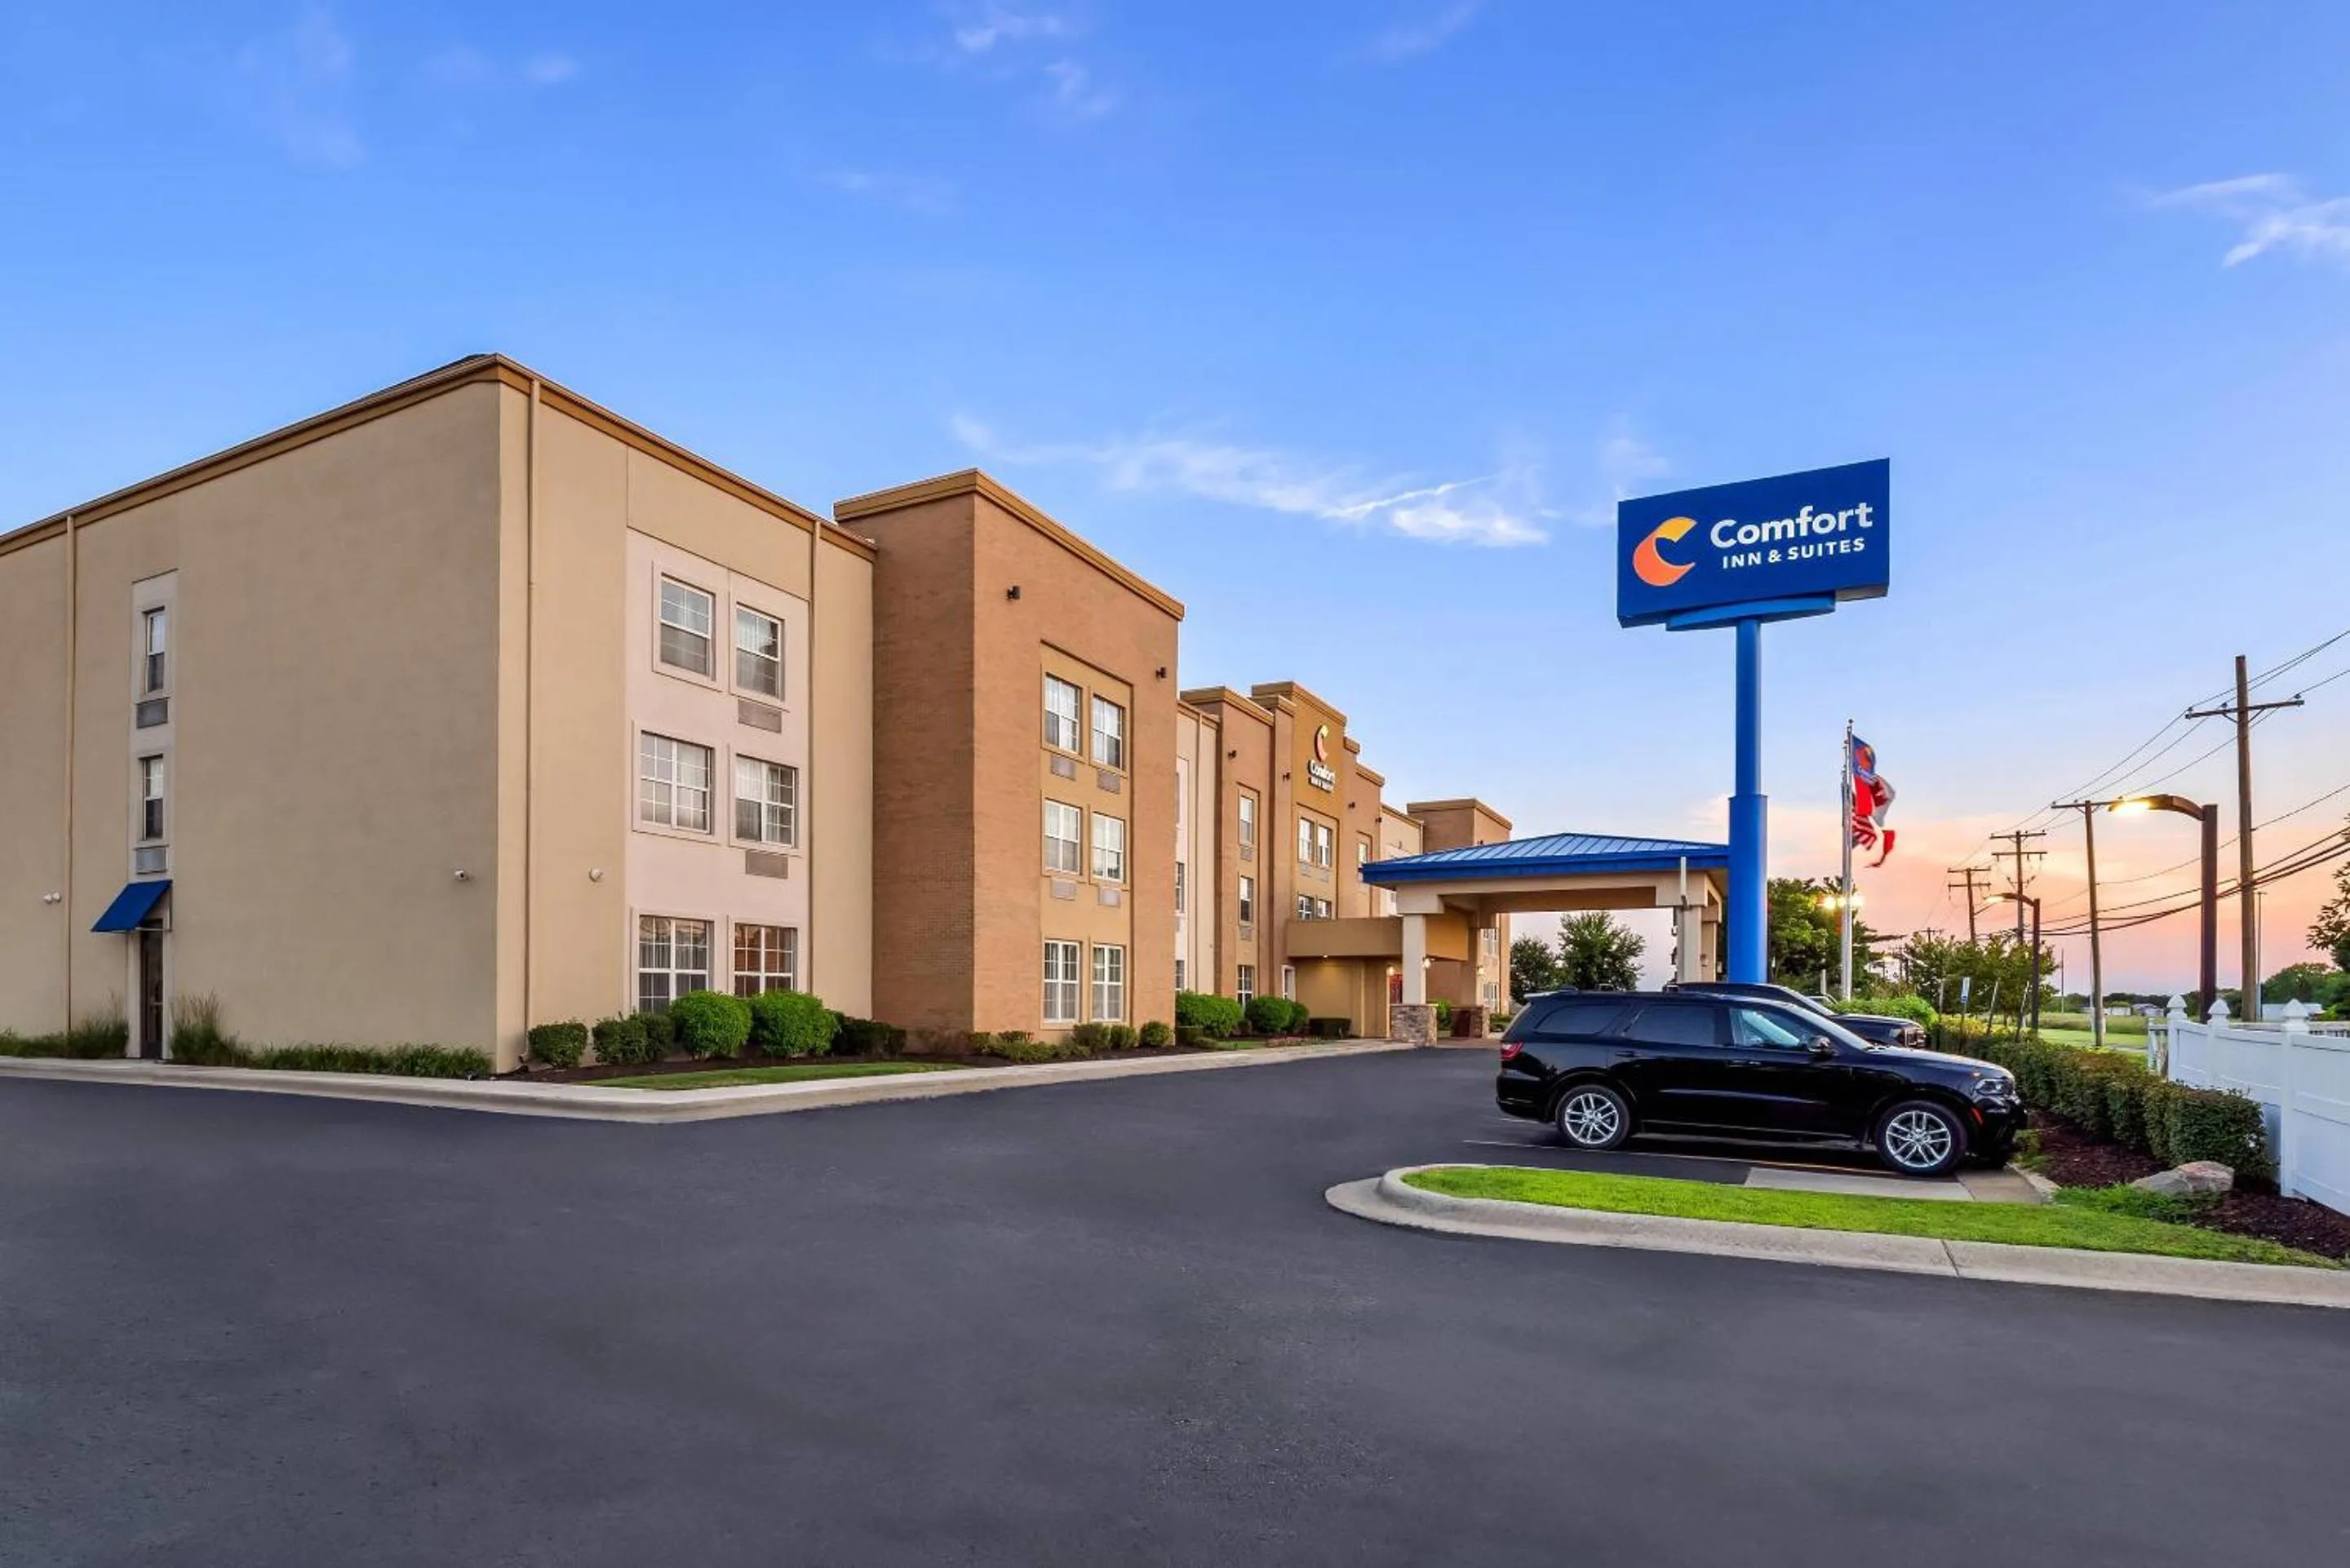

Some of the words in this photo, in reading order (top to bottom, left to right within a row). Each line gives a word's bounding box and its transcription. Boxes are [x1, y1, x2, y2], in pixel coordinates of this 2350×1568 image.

[1709, 503, 1873, 548] Comfort
[1723, 551, 1762, 569] INN
[1767, 549, 1782, 563] &
[1787, 538, 1865, 560] SUITES
